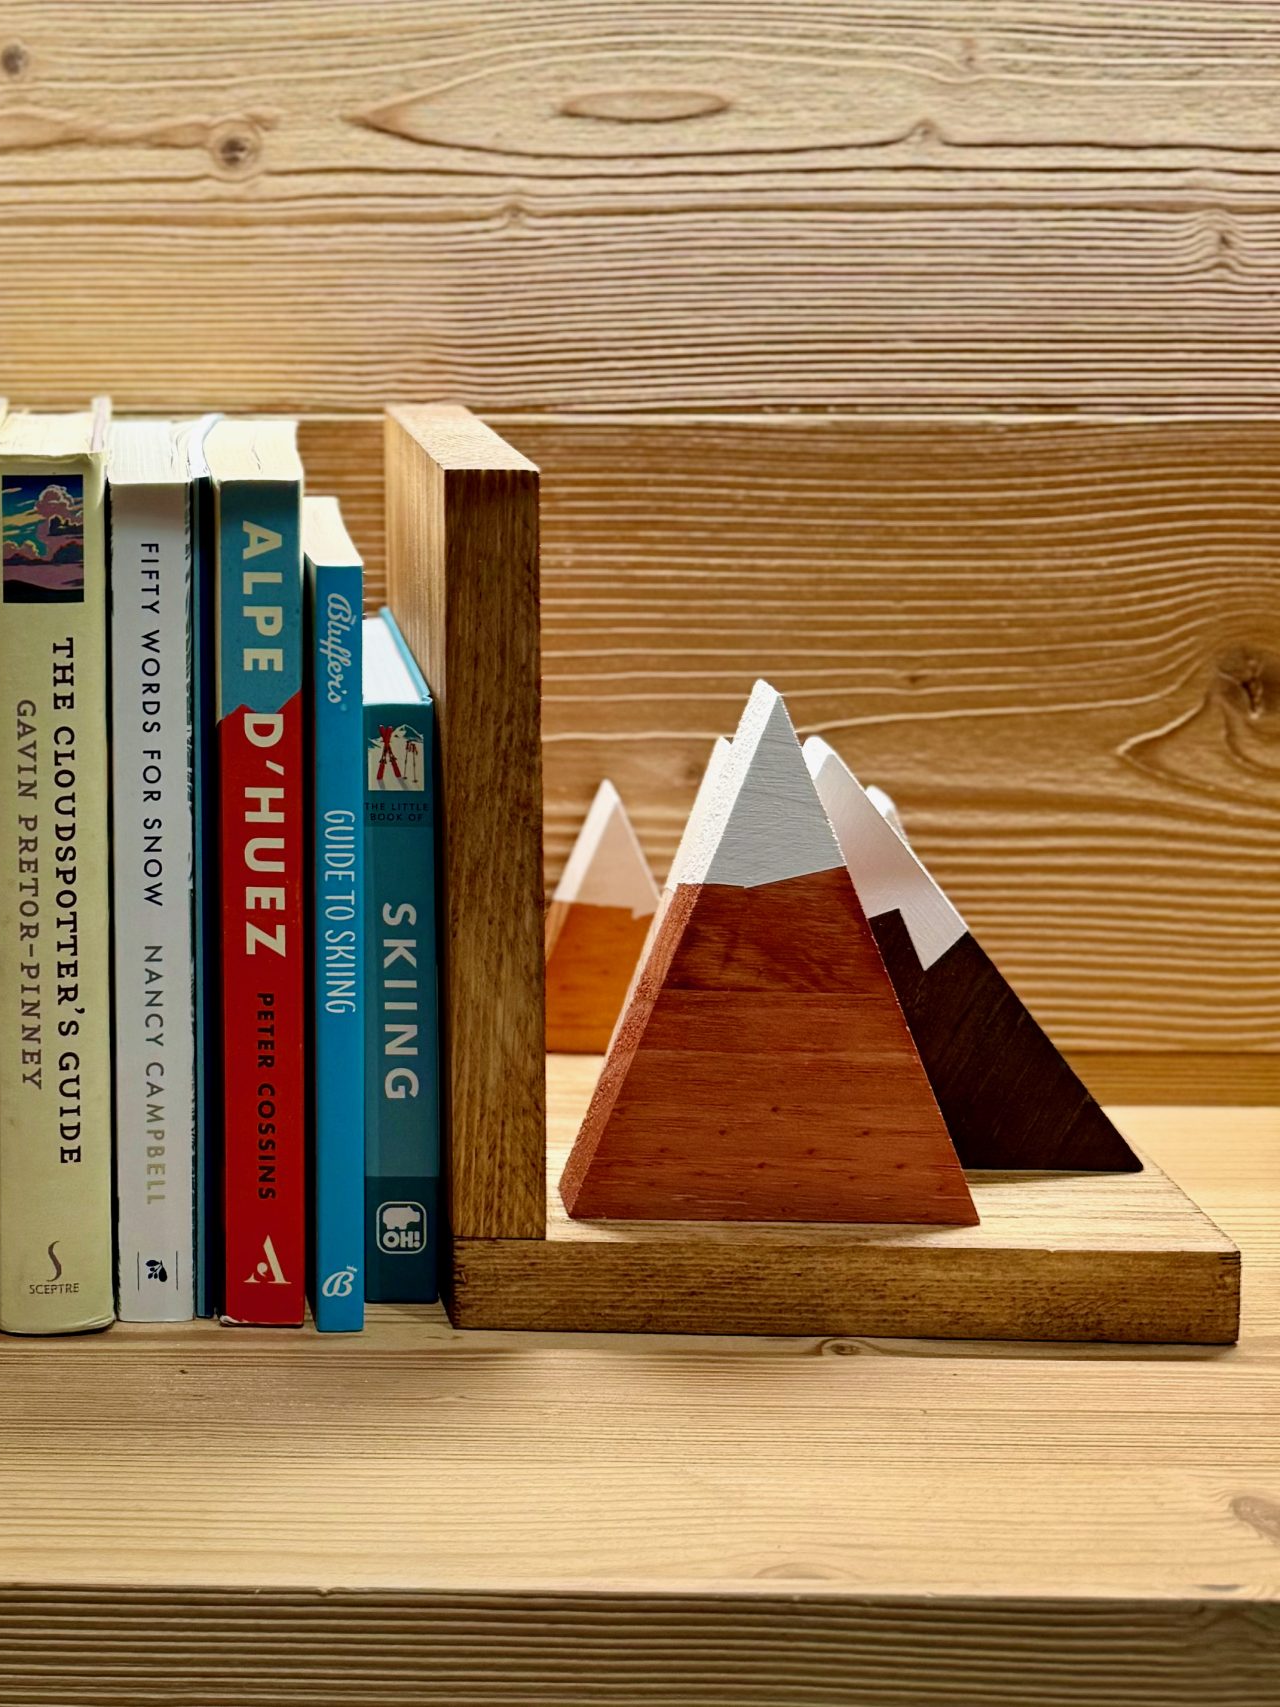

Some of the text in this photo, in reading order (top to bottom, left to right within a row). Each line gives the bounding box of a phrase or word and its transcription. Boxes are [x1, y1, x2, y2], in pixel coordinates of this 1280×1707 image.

[242, 520, 283, 673] ALPE
[53, 637, 75, 710] THE
[141, 543, 164, 907] FIFTY WORDS FOR SNOW
[365, 802, 429, 811] THE LITTLE
[370, 813, 424, 821] BOOK OF
[17, 699, 41, 1090] GAVIN PRETOR-PINNEY
[323, 810, 356, 1014] GUIDE TO SKIING
[144, 945, 166, 1205] NANCY CAMPBELL
[382, 903, 419, 1099] SKIING
[58, 1052, 81, 1164] GUIDE
[257, 992, 276, 1200] PETER COSSINS
[29, 1282, 79, 1295] SCEPTRE
[382, 1230, 420, 1247] OH!
